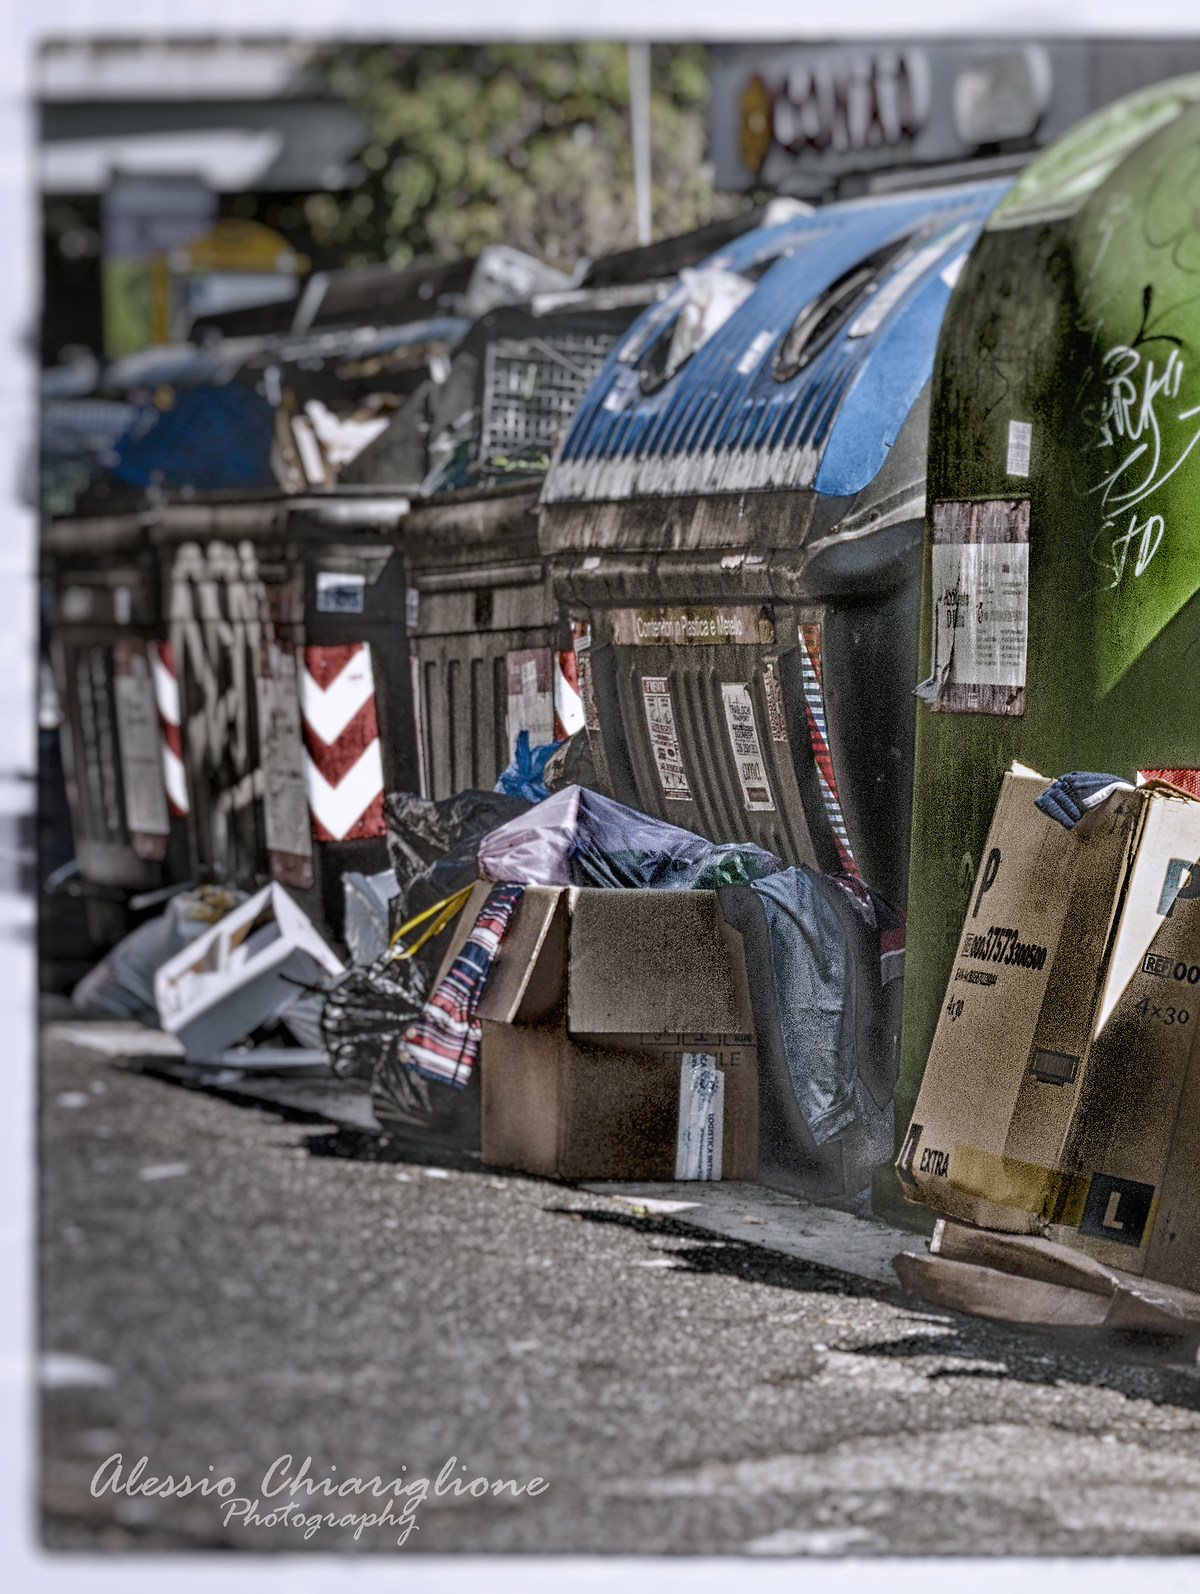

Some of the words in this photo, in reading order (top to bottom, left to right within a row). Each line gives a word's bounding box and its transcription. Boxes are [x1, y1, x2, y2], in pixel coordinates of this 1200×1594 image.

[972, 848, 1001, 918] P
[1145, 956, 1173, 975] REF
[1135, 998, 1190, 1026] 4x30
[707, 1113, 716, 1152] LOGISTICA
[920, 1147, 949, 1177] EXTRA
[1102, 1190, 1123, 1230] L
